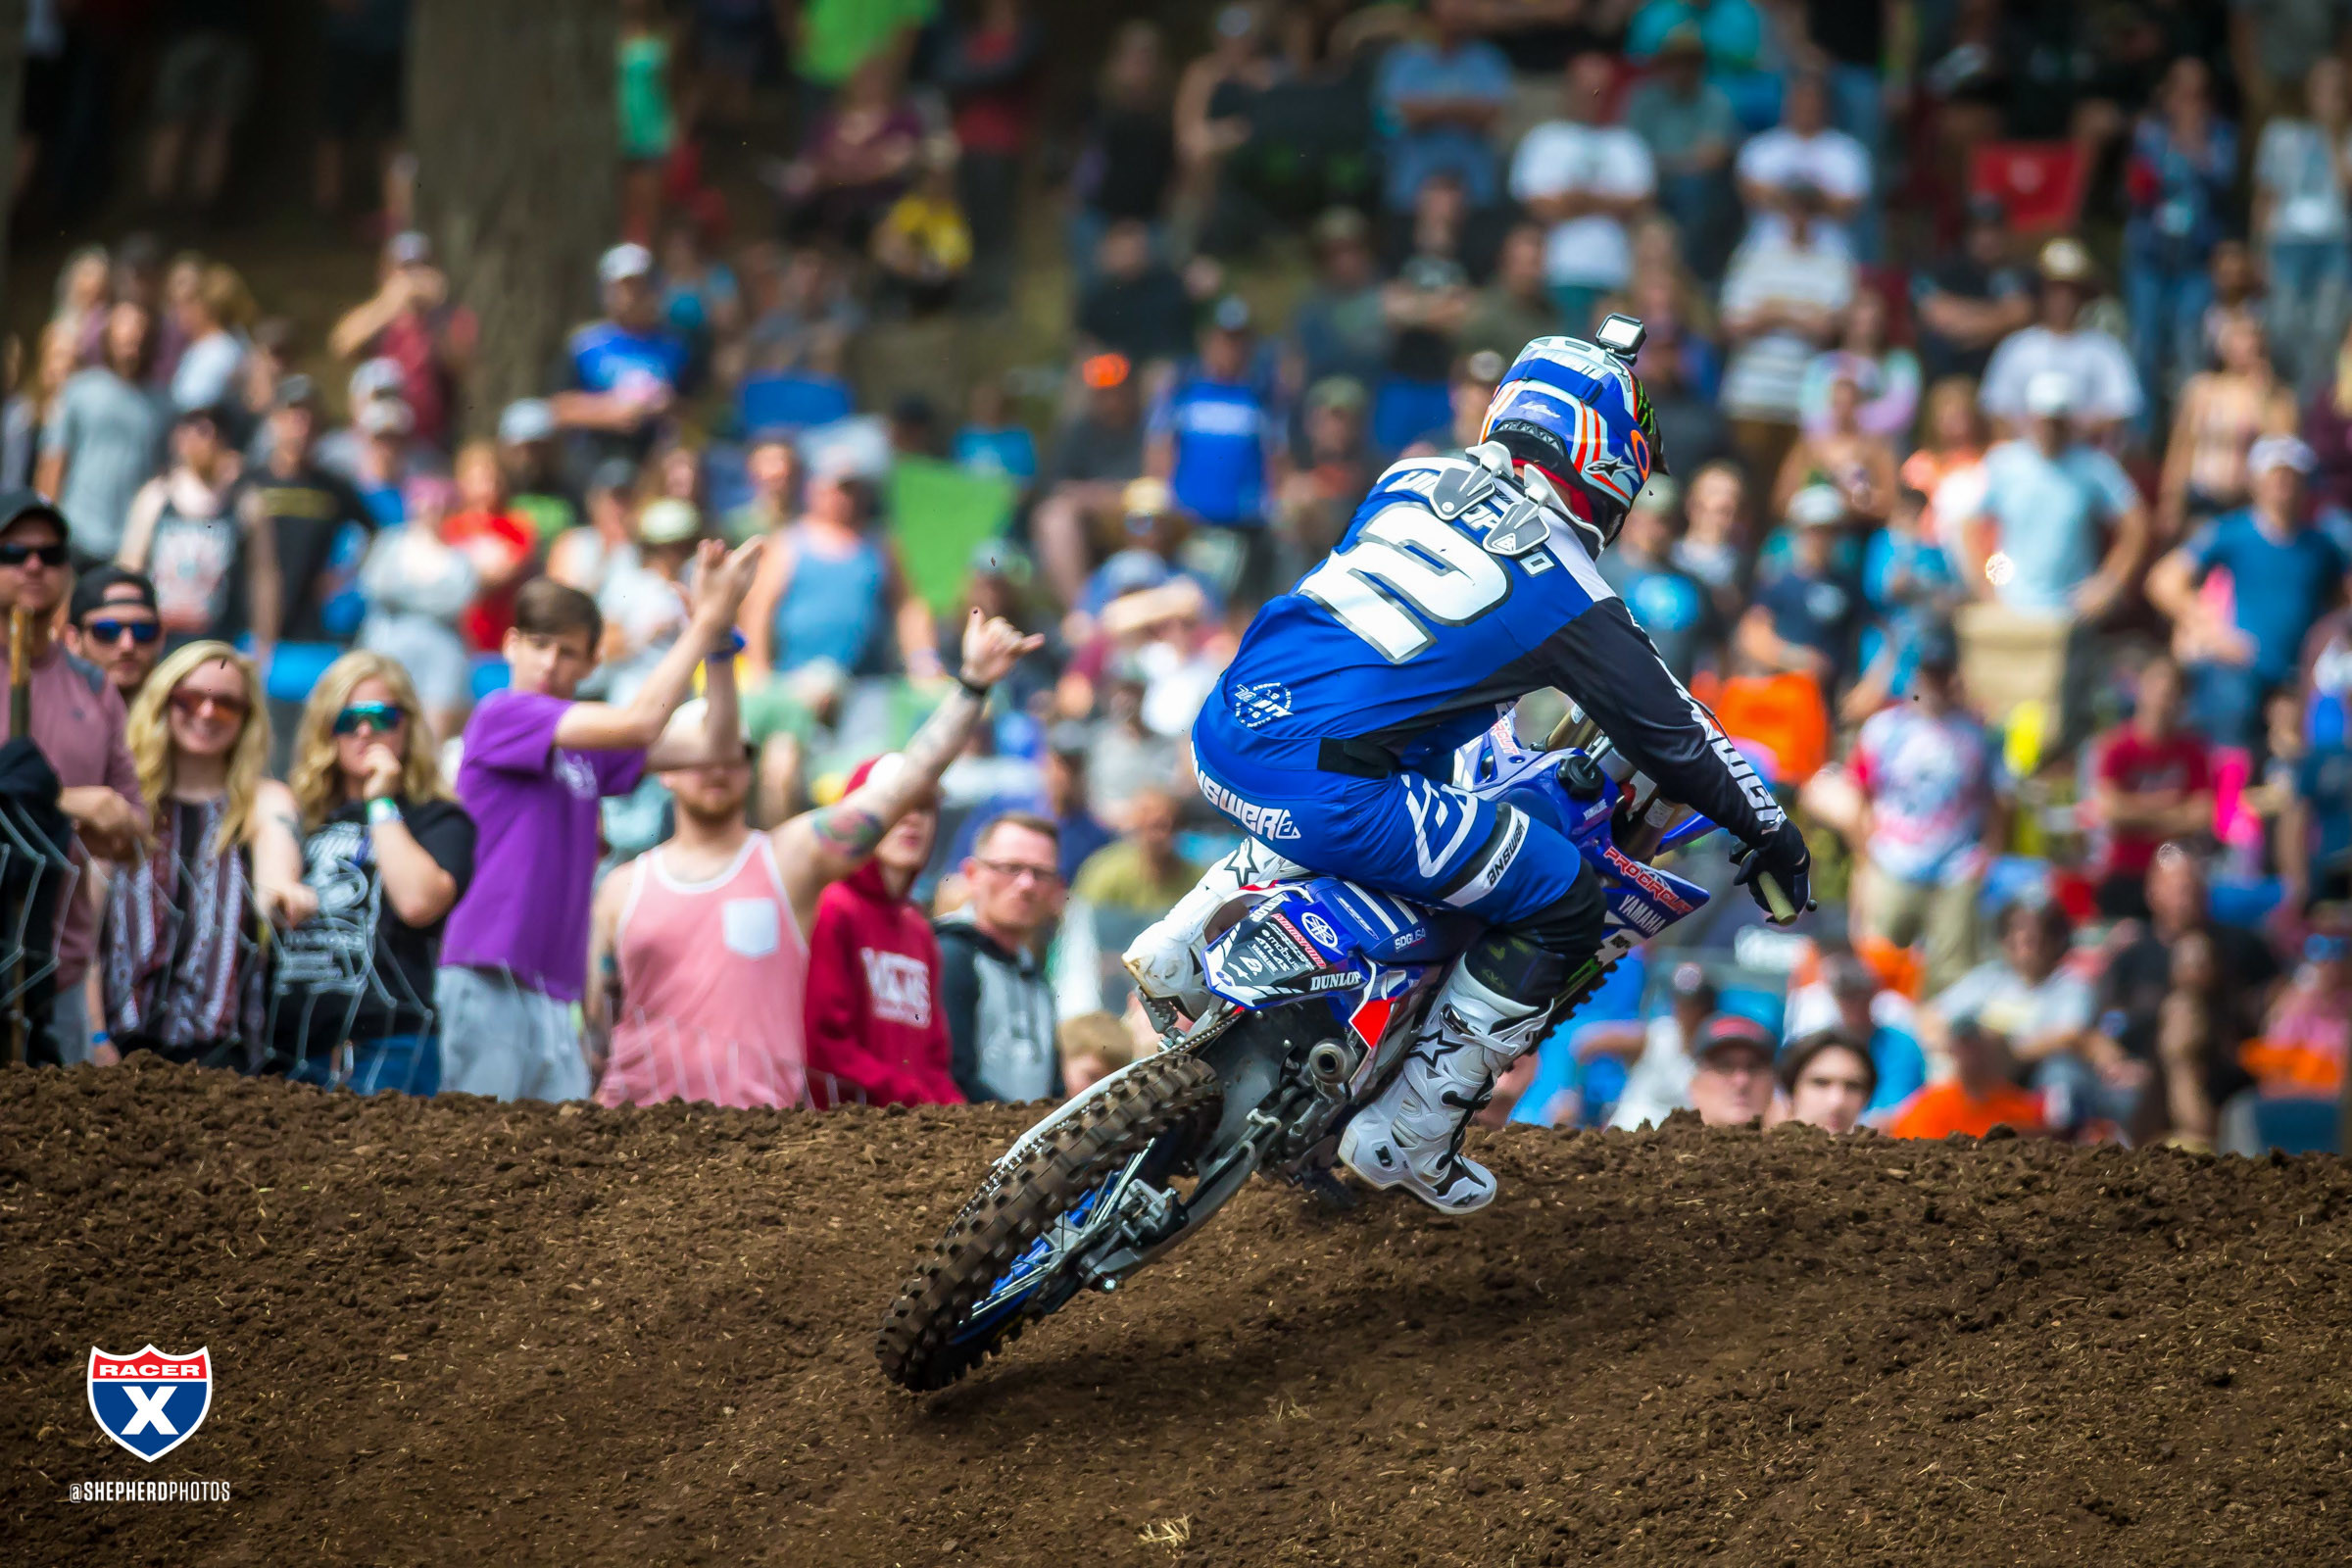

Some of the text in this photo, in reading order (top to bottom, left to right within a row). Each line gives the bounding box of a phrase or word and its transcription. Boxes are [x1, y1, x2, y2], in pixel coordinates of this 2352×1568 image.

[1297, 502, 1512, 664] 2
[1603, 845, 1694, 915] PRO CIRCUIT
[1618, 894, 1666, 934] YAMAHA
[1251, 943, 1279, 972] YAMALUBE
[1254, 936, 1291, 972] ATLAS
[1268, 936, 1301, 972] mobius
[1309, 970, 1361, 991] DUNLOP
